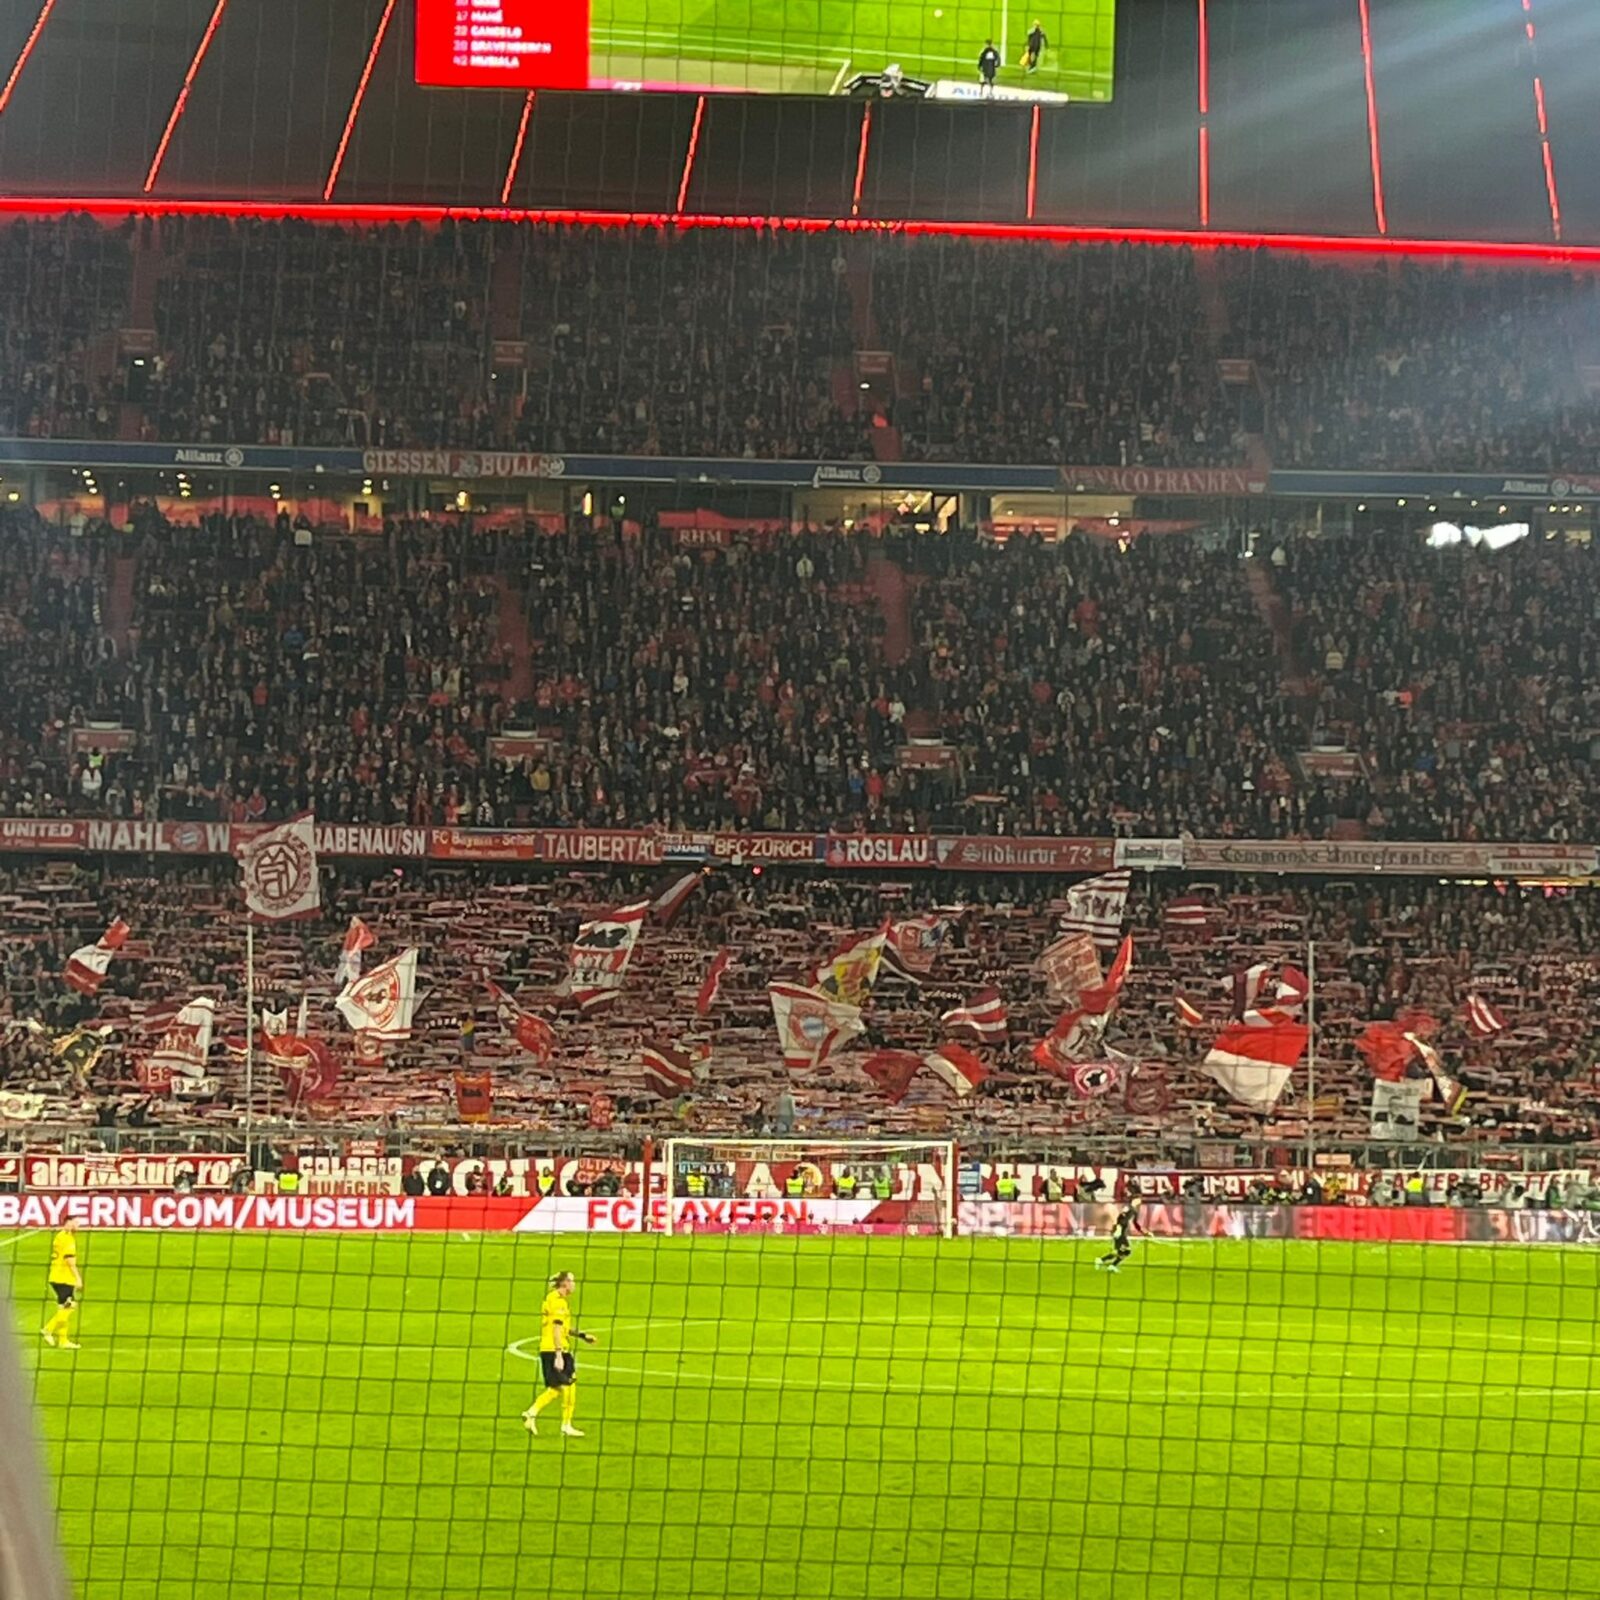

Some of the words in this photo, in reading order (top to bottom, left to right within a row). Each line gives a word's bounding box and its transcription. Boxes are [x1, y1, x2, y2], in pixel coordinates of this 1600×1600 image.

[174, 448, 221, 463] Allianz
[362, 451, 449, 474] GIESSEN
[815, 466, 860, 481] Allianz
[1502, 480, 1548, 493] Allianz
[3, 822, 74, 837] UNITED
[714, 838, 748, 856] BFC
[846, 839, 928, 862] ROSLAU
[0, 1195, 414, 1228] BAYERN.COM/MUSEUM
[587, 1200, 635, 1229] FC
